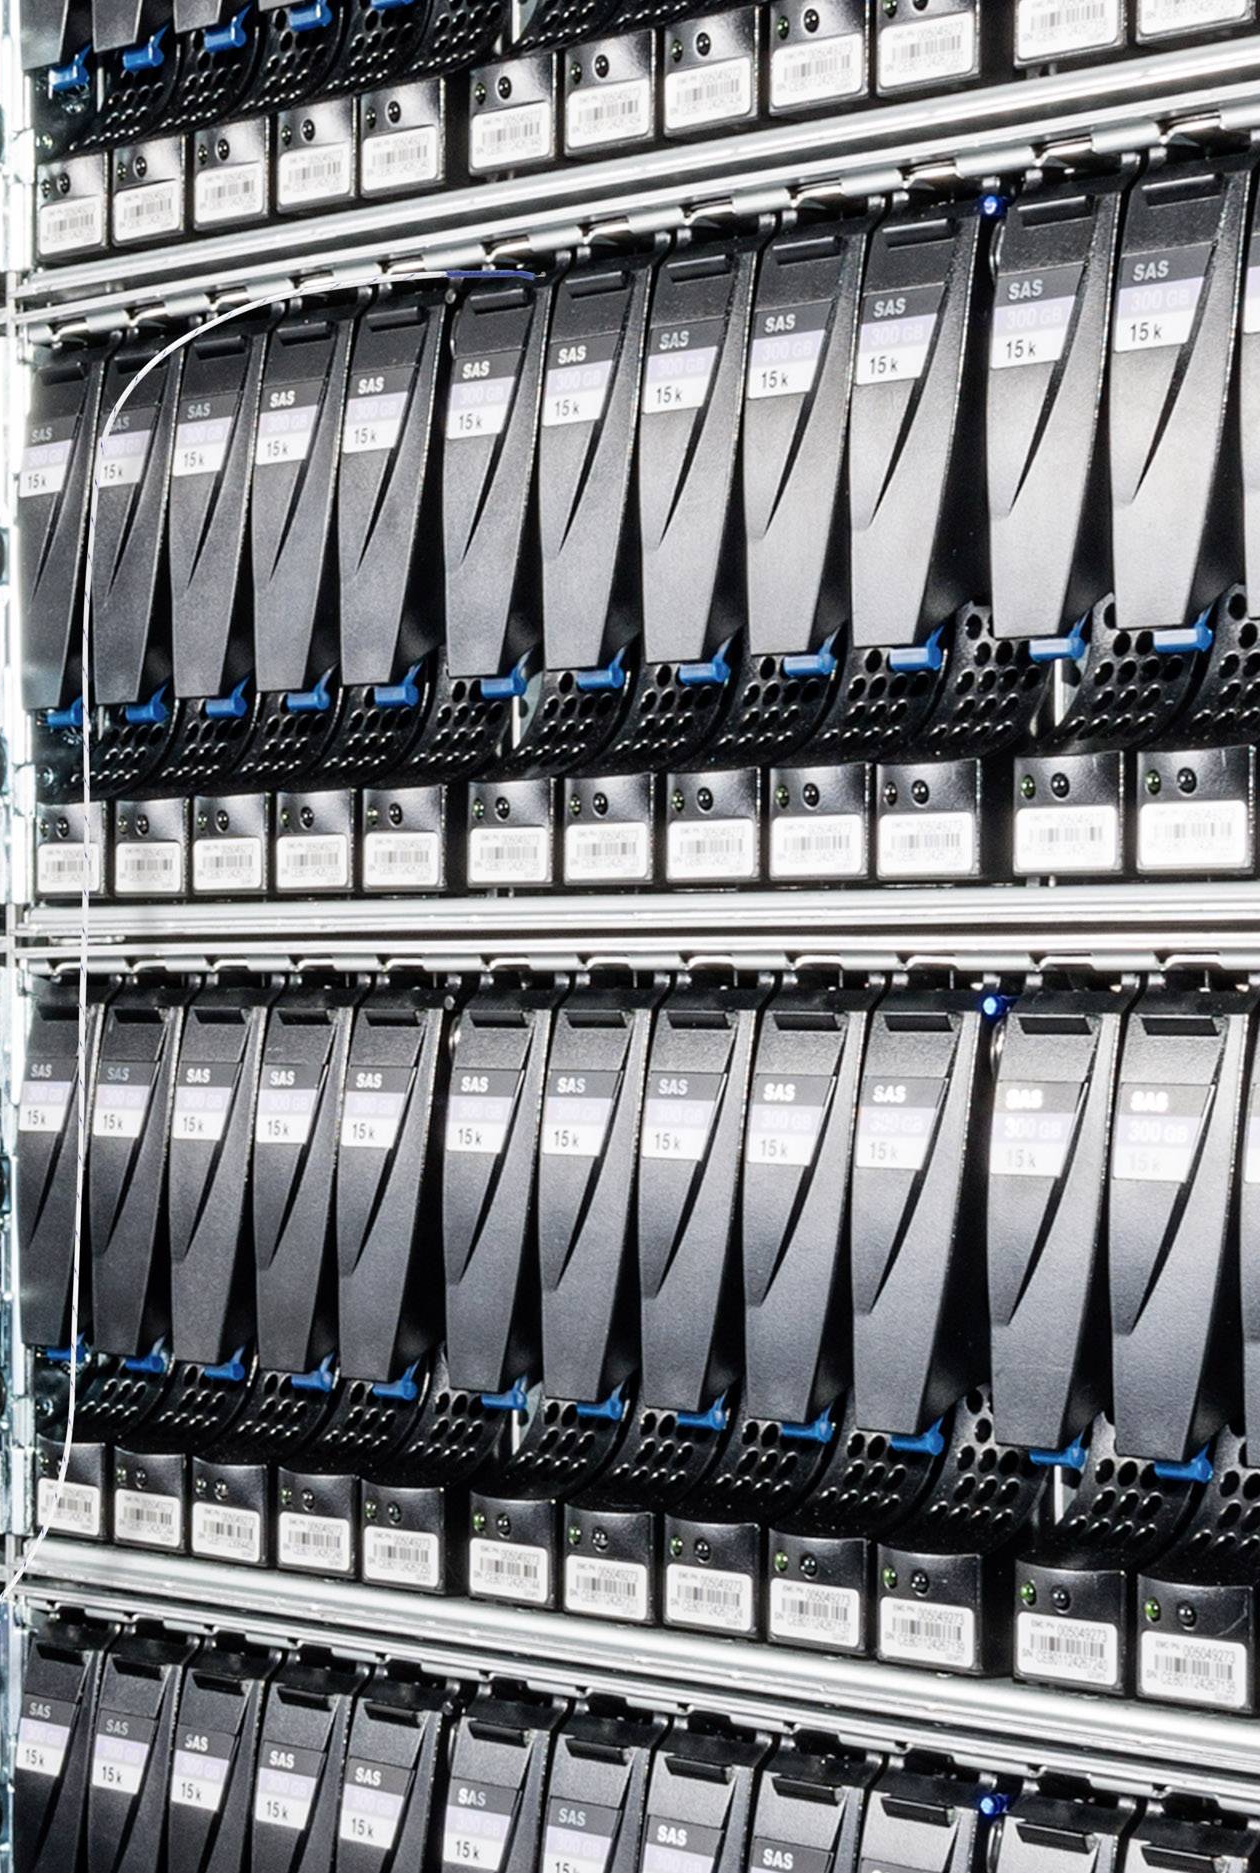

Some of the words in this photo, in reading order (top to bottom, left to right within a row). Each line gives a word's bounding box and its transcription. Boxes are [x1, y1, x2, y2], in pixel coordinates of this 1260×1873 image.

[1133, 261, 1169, 281] SAS
[1008, 279, 1043, 300] SAS
[873, 297, 906, 317] SAS
[765, 314, 795, 333] SAS
[659, 331, 689, 349] SAS
[558, 346, 586, 364] SAS
[462, 361, 489, 378] SAS
[358, 377, 384, 394] SAS
[270, 391, 295, 408] SAS
[188, 403, 211, 419] SAS
[31, 427, 52, 442] SAS
[31, 1064, 52, 1078] SAS
[107, 1067, 129, 1081] SAS
[187, 1068, 210, 1083] SAS
[270, 1071, 295, 1086] SAS
[356, 1073, 382, 1088] SAS
[461, 1076, 488, 1092] SAS
[557, 1078, 586, 1093] SAS
[659, 1079, 688, 1095] SAS
[764, 1083, 796, 1101] SAS
[872, 1085, 906, 1103] SAS
[29, 1702, 51, 1718] SAS
[106, 1719, 129, 1736] SAS
[185, 1734, 208, 1751] SAS
[269, 1751, 294, 1769] SAS
[355, 1767, 381, 1786] SAS
[458, 1787, 486, 1807] SAS
[558, 1807, 586, 1827] SAS
[657, 1825, 687, 1846] SAS
[763, 1849, 794, 1869] SAS
